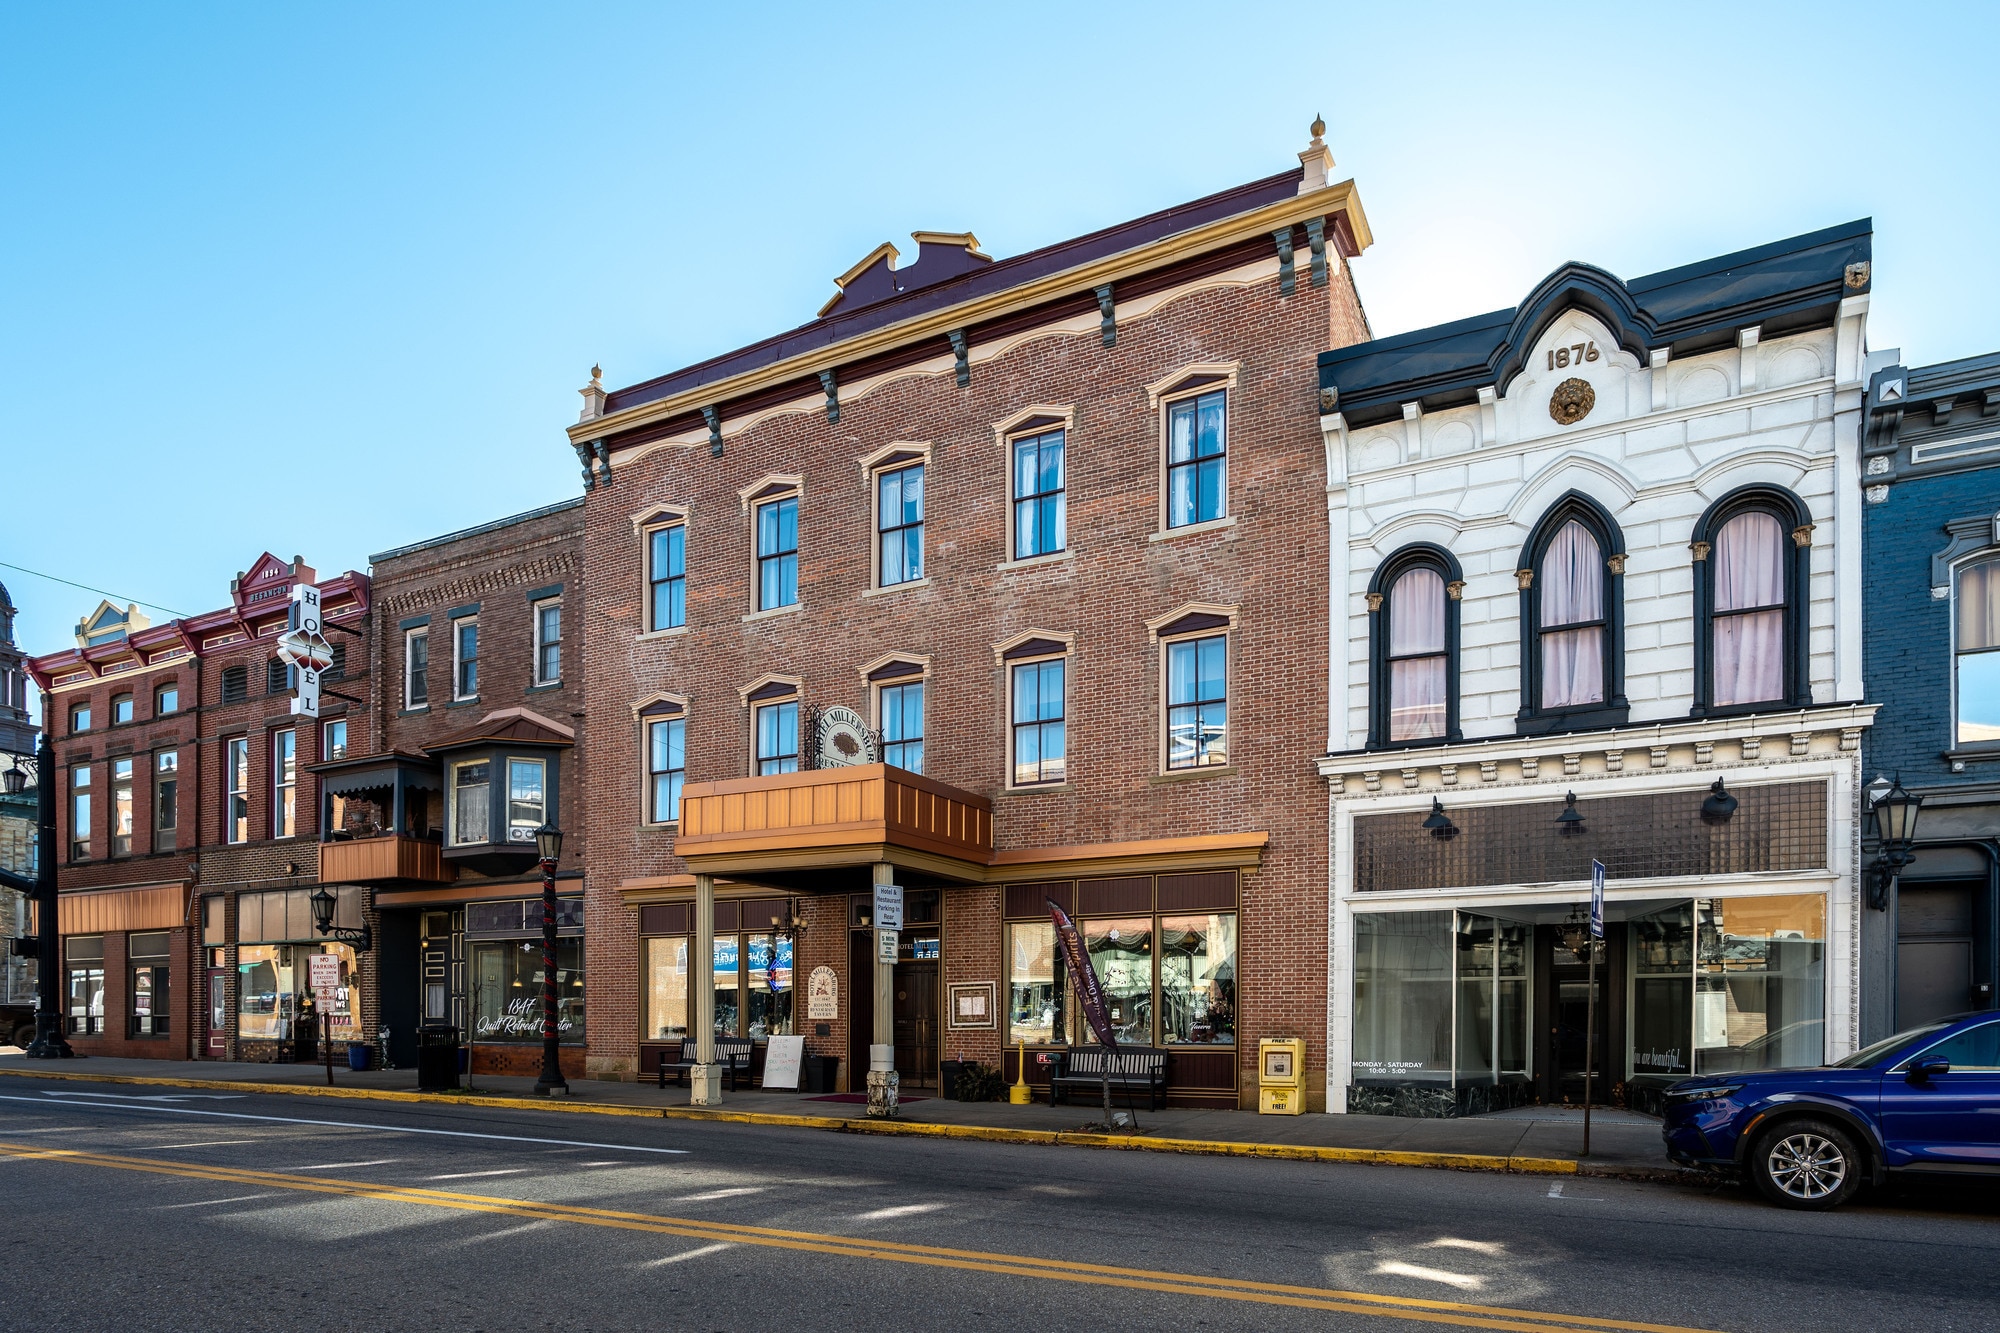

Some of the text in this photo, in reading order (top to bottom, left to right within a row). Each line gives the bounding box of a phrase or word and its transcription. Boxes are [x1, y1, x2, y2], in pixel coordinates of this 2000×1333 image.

[1548, 341, 1600, 371] 1876
[304, 591, 318, 711] HOTEL
[829, 710, 875, 764] MILLERSBUR
[1592, 867, 1603, 915] H
[878, 905, 895, 913] Parking
[508, 998, 537, 1014] 1847
[476, 1015, 573, 1034] Quilt Retreat Cter
